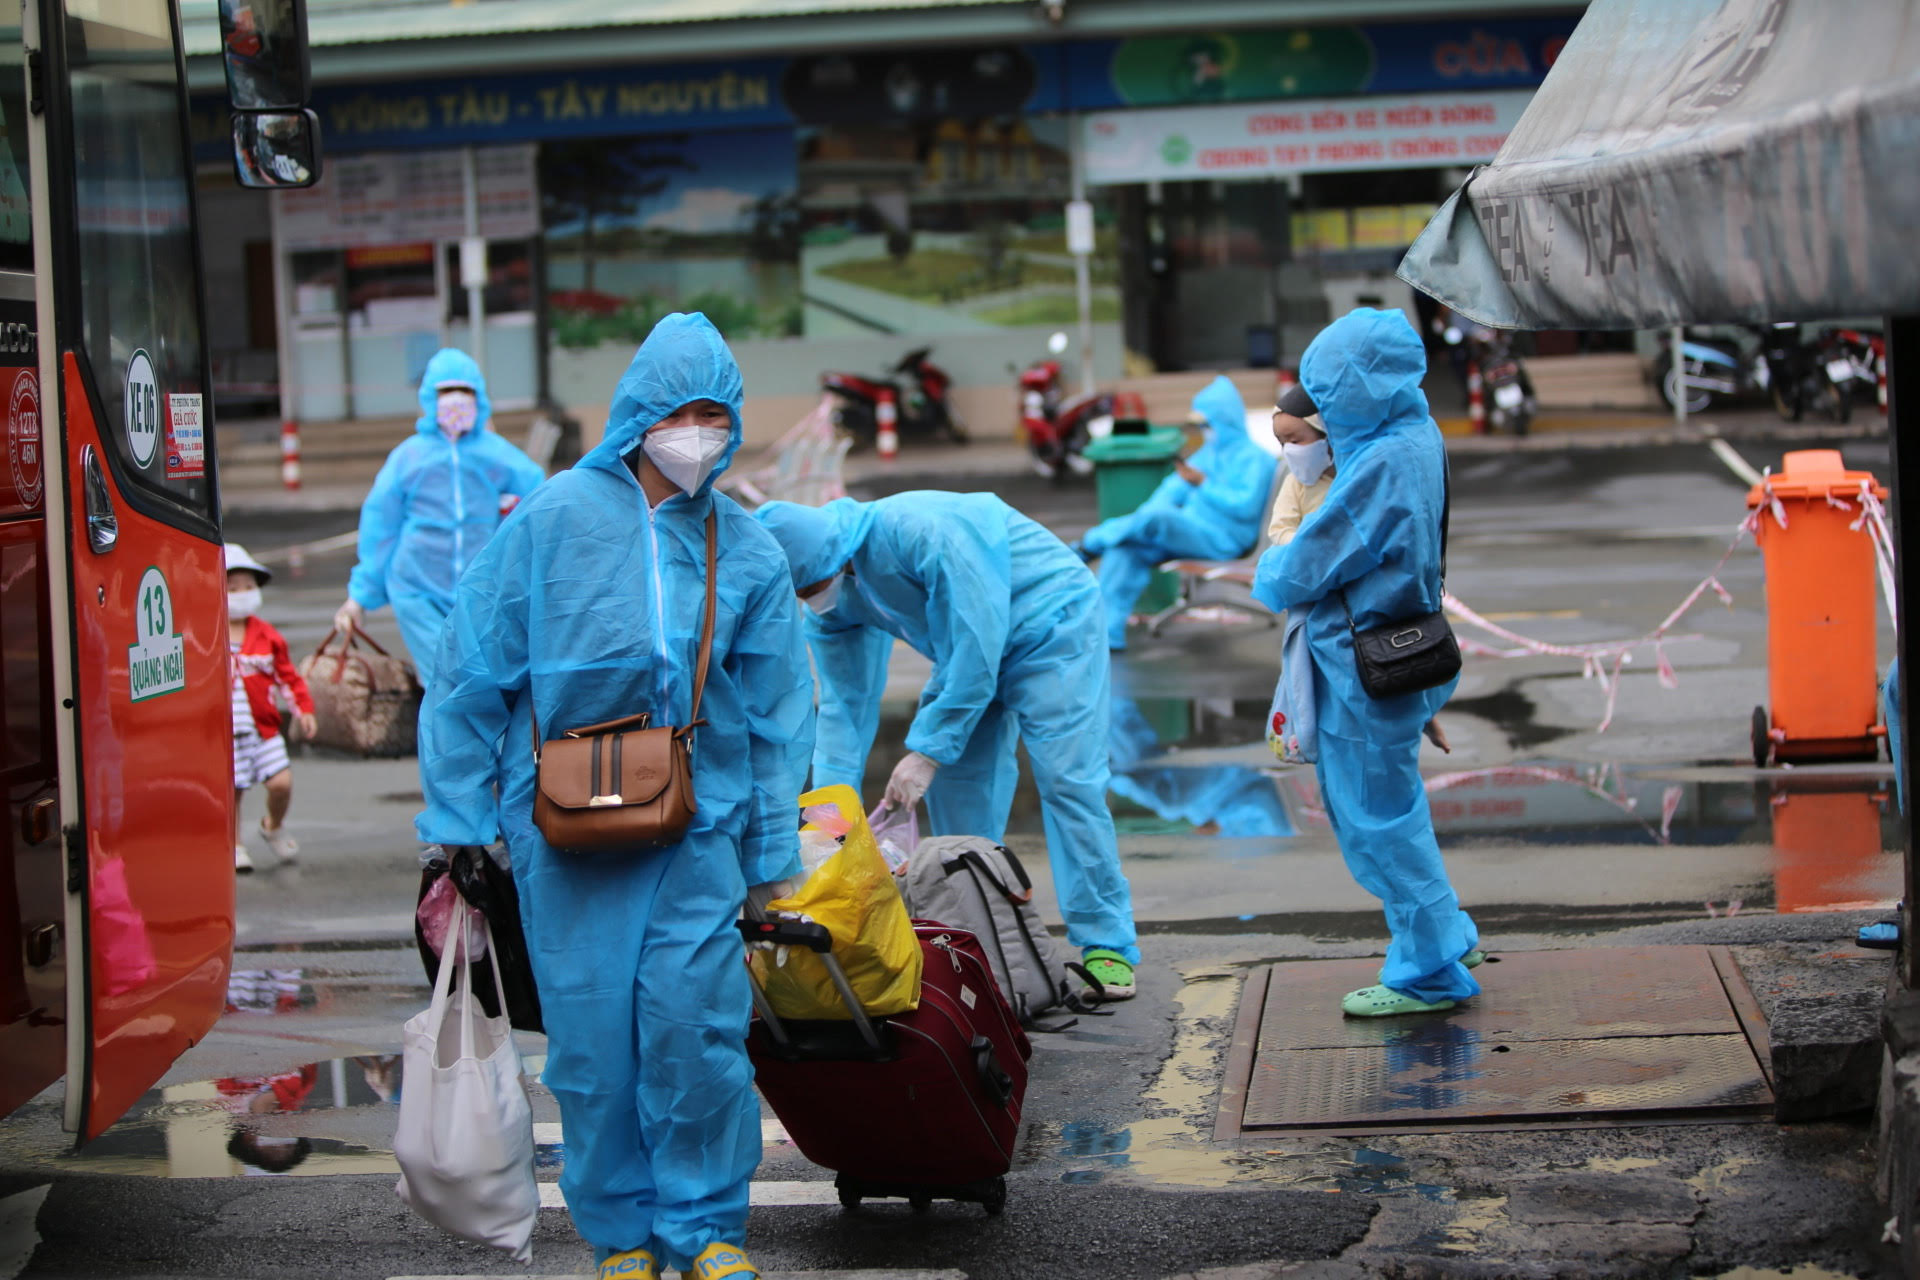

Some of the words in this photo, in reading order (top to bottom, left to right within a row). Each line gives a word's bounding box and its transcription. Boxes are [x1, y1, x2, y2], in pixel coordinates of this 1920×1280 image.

[439, 86, 510, 128] TÀU
[538, 79, 606, 121] TÂY
[616, 70, 768, 117] NGUYÊN
[130, 382, 142, 432] XE
[144, 383, 155, 434] 06
[144, 584, 166, 637] 13
[132, 647, 162, 696] QUẢNG
[162, 645, 183, 684] NGÃI
